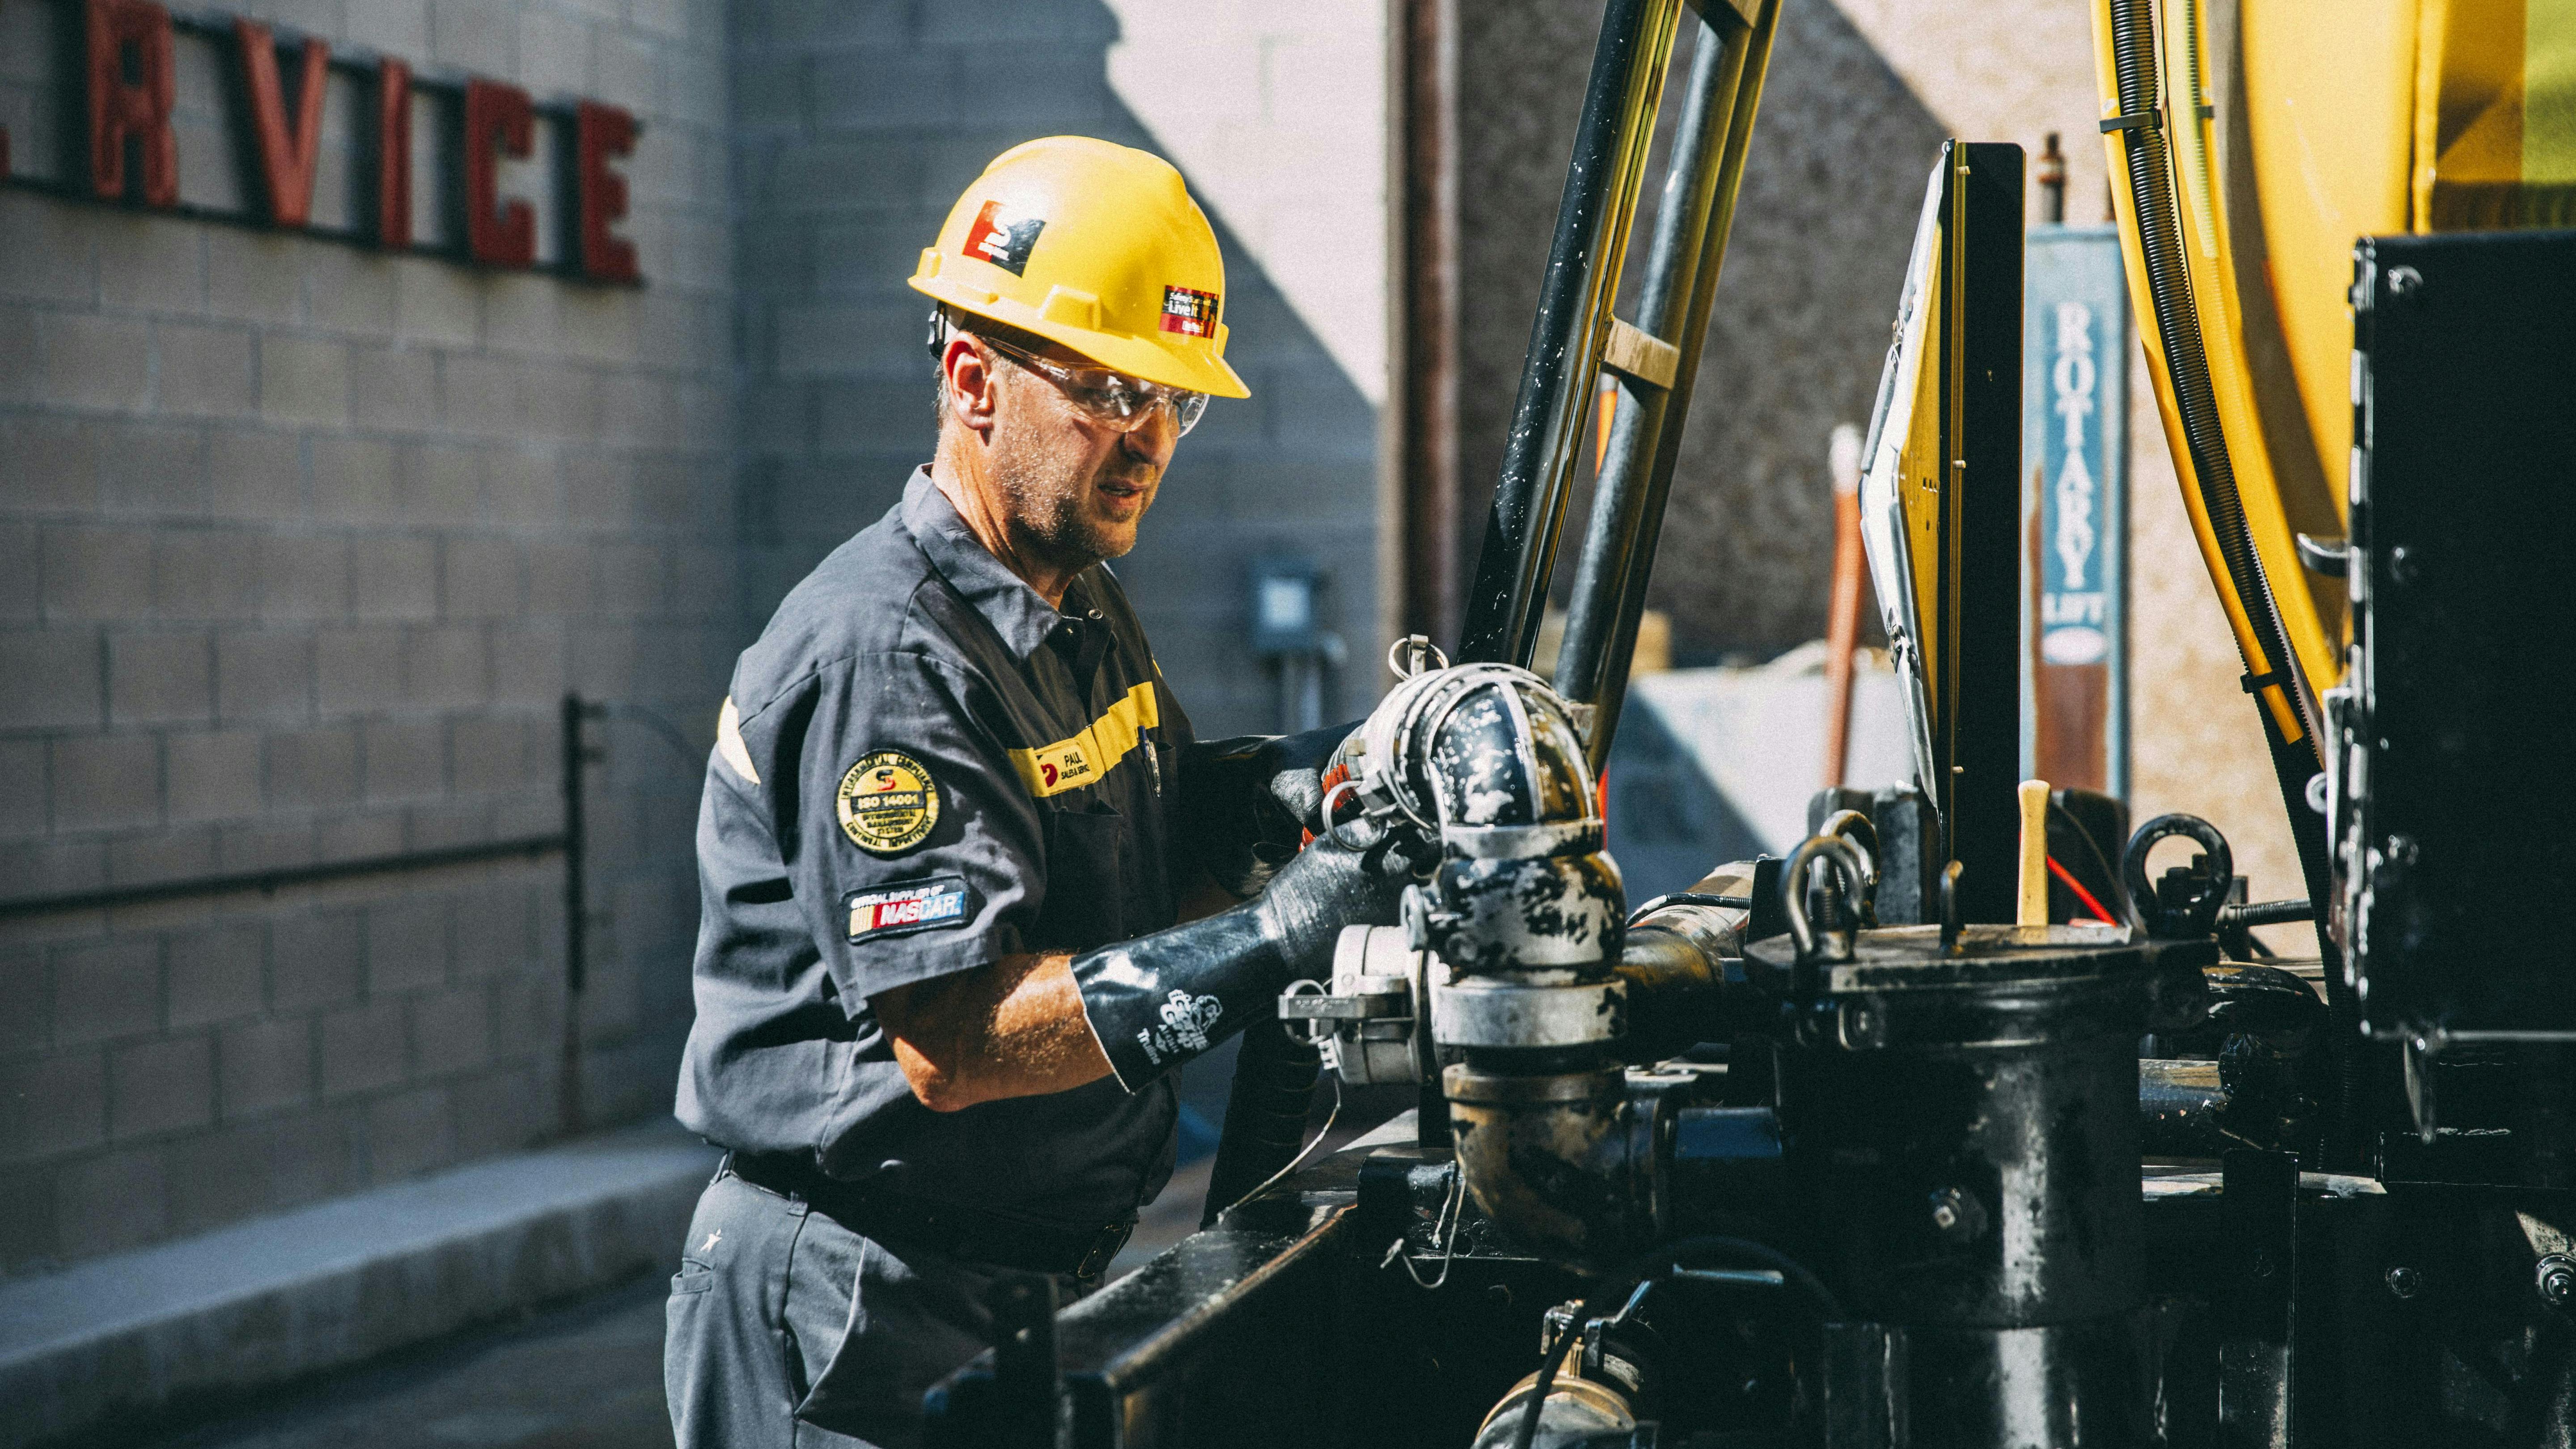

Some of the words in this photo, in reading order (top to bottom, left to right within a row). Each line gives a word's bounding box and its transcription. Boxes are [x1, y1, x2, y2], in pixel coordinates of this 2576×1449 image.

[0, 0, 637, 281] RVICE
[1168, 300, 1191, 316] Live
[1191, 304, 1198, 317] It
[2054, 302, 2096, 589] ROTARY
[2042, 593, 2105, 622] LIFT
[1064, 752, 1082, 767] PAUL
[858, 797, 880, 809] ISO
[882, 794, 918, 807] 14001
